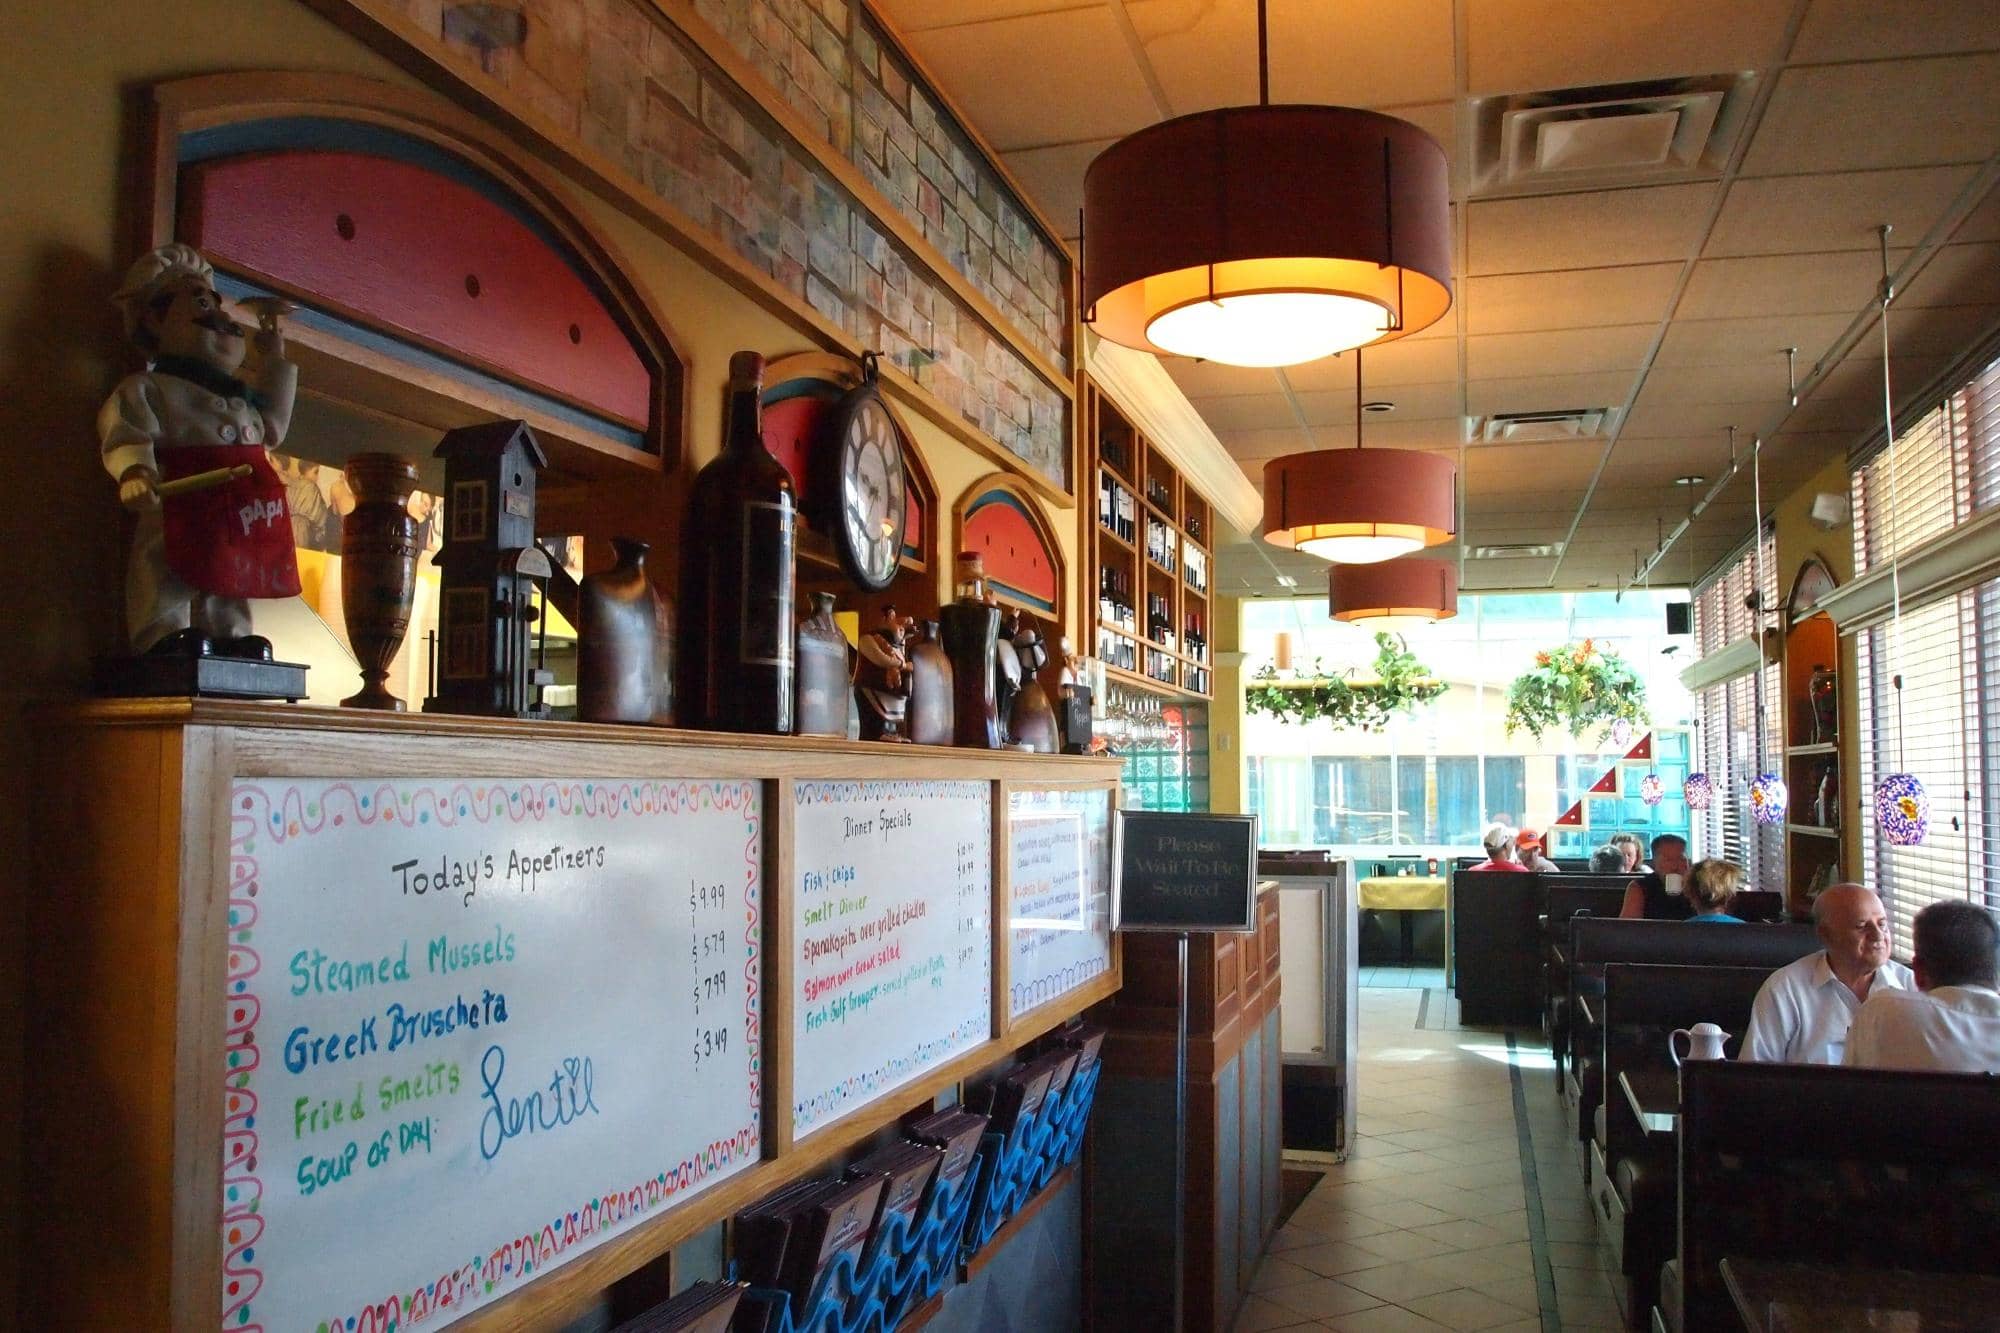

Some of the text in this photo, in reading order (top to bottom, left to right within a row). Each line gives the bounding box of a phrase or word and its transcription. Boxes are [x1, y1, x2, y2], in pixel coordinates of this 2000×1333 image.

[844, 809, 912, 842] Dinner Specials
[392, 846, 605, 907] Today's Appetizers
[804, 871, 823, 893] Fish
[860, 923, 875, 940] over
[878, 904, 900, 941] grilled
[289, 924, 515, 996] Steamed Mussels
[804, 976, 837, 1001] Salmon
[837, 966, 853, 985] over
[806, 1005, 827, 1034] Fresh
[294, 1082, 365, 1139] Fried
[480, 1045, 600, 1160] Lentil
